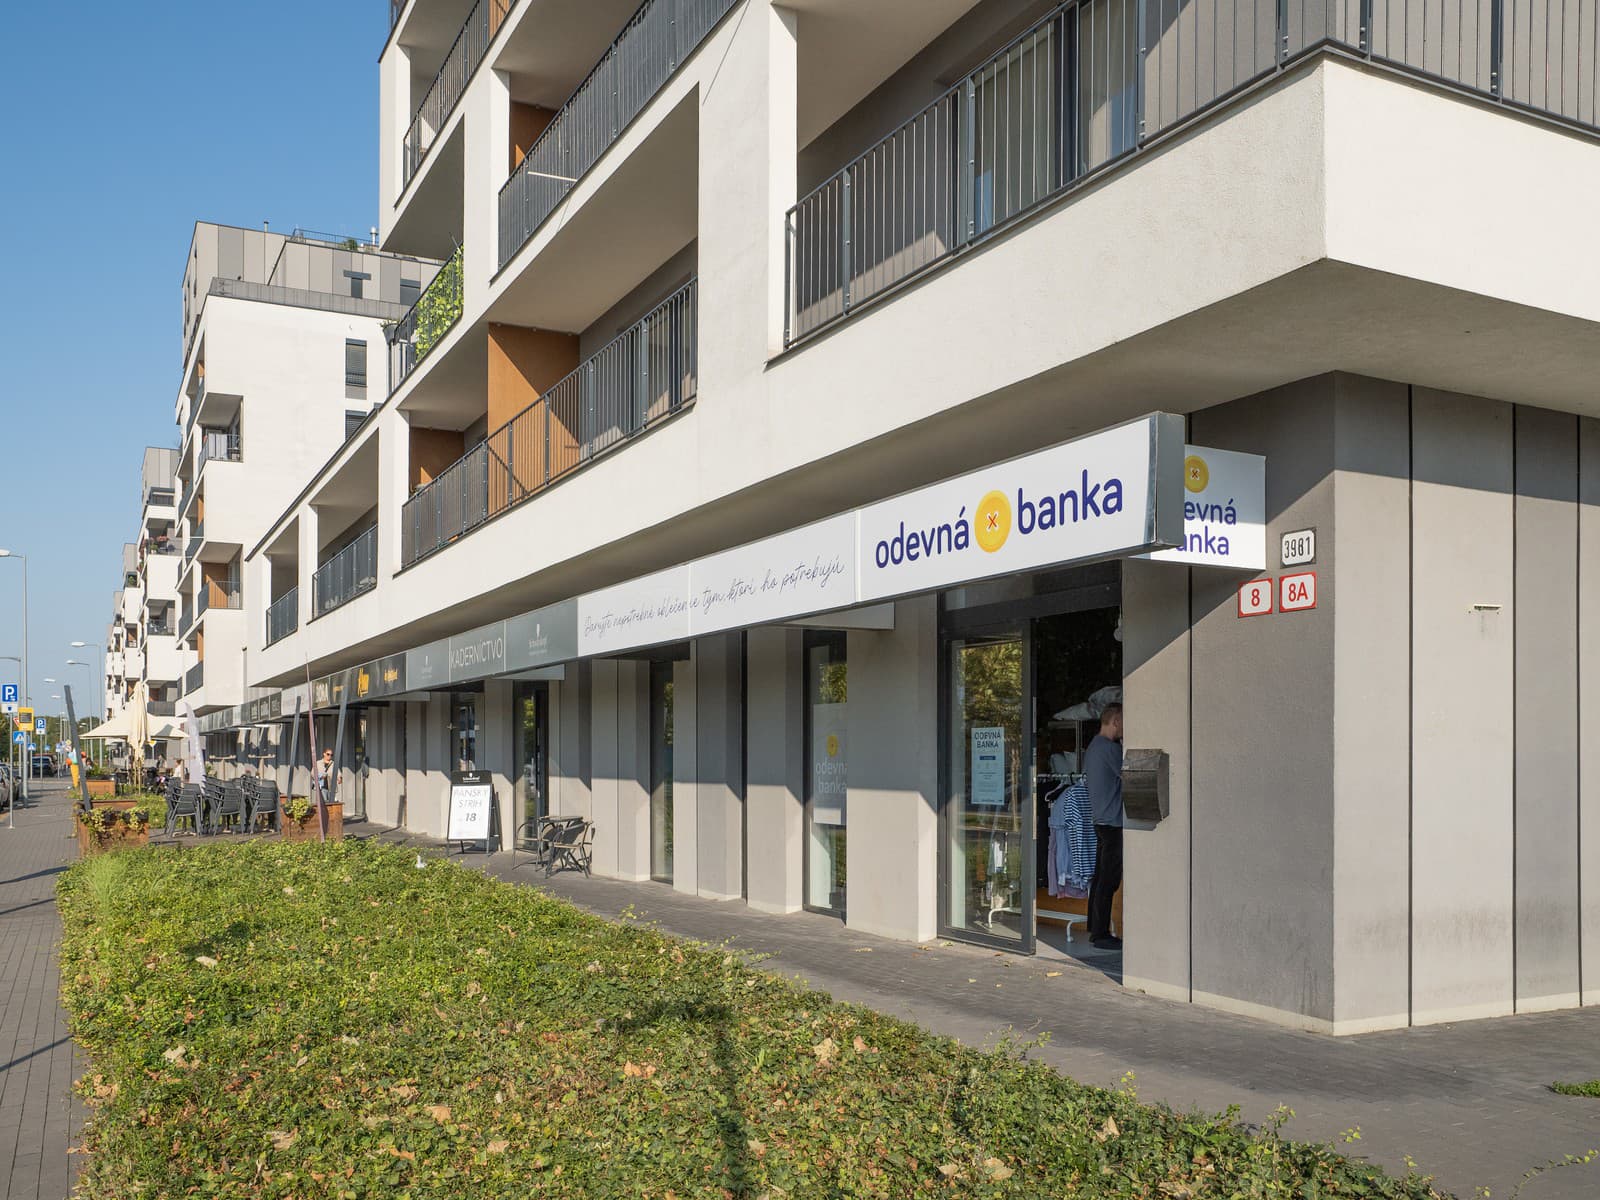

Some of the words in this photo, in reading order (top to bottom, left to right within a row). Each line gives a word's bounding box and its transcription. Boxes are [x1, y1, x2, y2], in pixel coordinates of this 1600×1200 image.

[875, 506, 969, 568] odevná
[1017, 469, 1123, 534] banka
[1184, 498, 1237, 525] evná
[1176, 525, 1230, 555] anka
[1284, 536, 1310, 559] 3981
[760, 567, 779, 593] ho
[779, 554, 846, 594] potrebujú
[1251, 588, 1261, 607] 8
[1288, 581, 1309, 602] 8A
[450, 638, 503, 669] KADERNÍCTVO
[5, 686, 15, 701] P
[976, 740, 999, 749] BANKA
